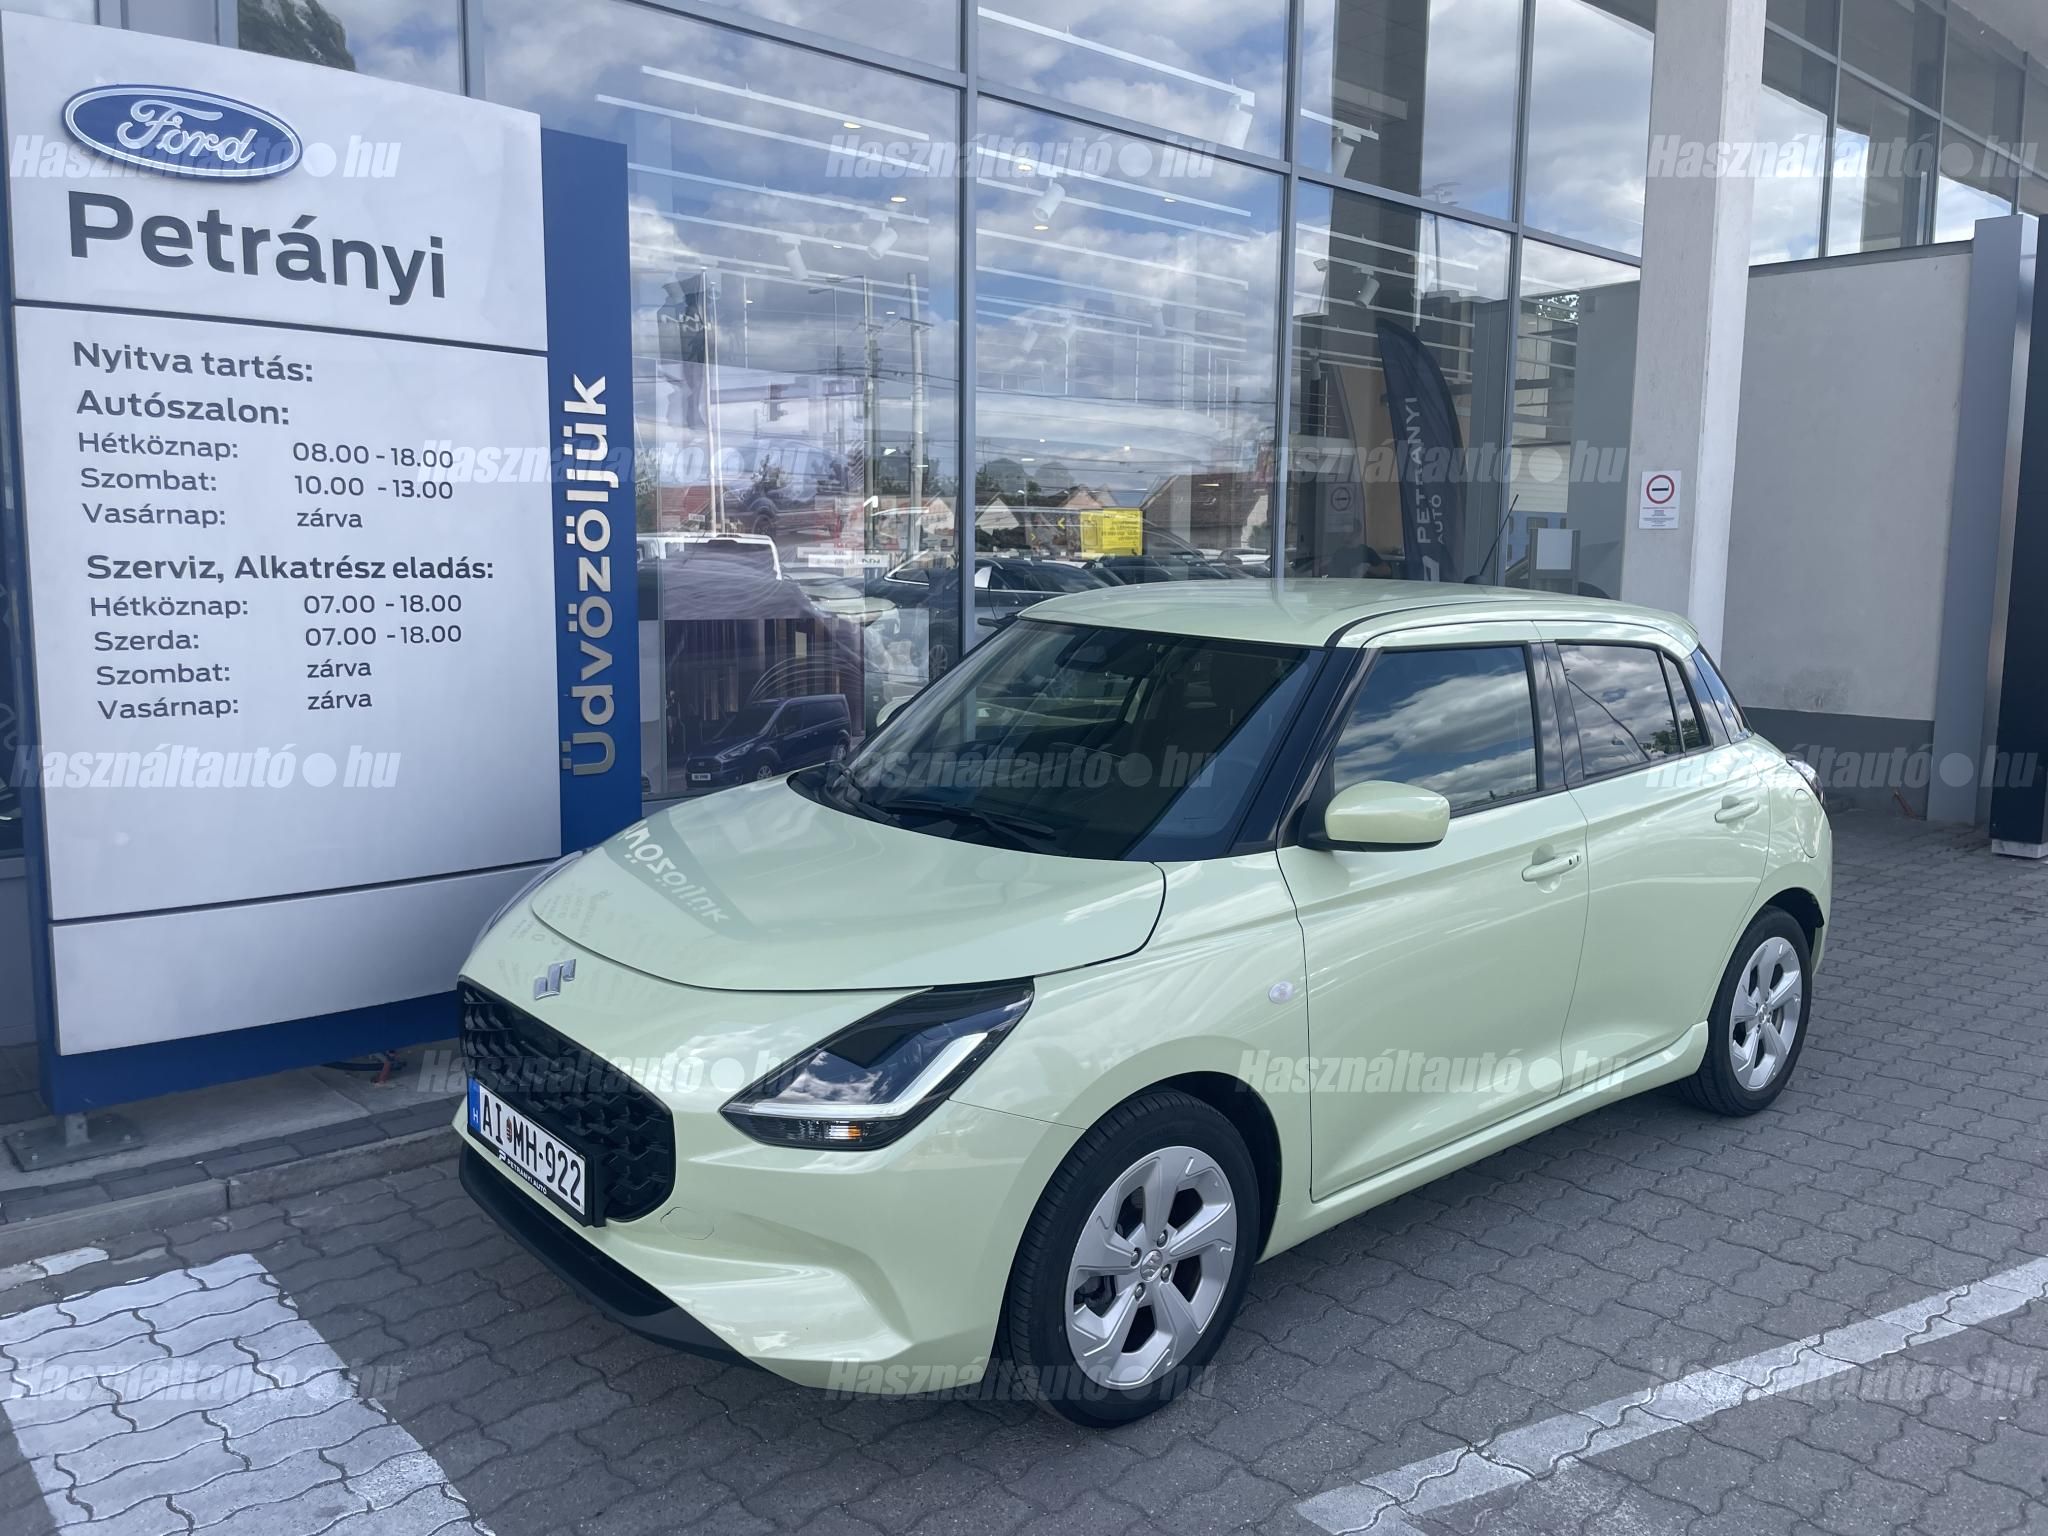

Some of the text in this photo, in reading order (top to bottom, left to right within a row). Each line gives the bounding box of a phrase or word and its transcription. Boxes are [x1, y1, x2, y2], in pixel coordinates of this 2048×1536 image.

[116, 98, 259, 165] Ford
[67, 190, 447, 306] Petrányi
[72, 340, 313, 383] Nyitva tartás:
[75, 389, 290, 426] Autószalon:
[78, 431, 239, 462] Hétköznap:
[80, 466, 217, 492] Szombat:
[80, 502, 364, 529] Vasárnap: zárva
[86, 554, 494, 584] Szerviz, Alkatrész eladás:
[562, 373, 621, 777] Üdvözöljük
[89, 595, 249, 620] Hétköznap:
[93, 629, 200, 652] Szerda:
[95, 657, 373, 686] Szombat: zárva
[96, 689, 373, 720] Vasárnap: zárva
[471, 1107, 479, 1124] H
